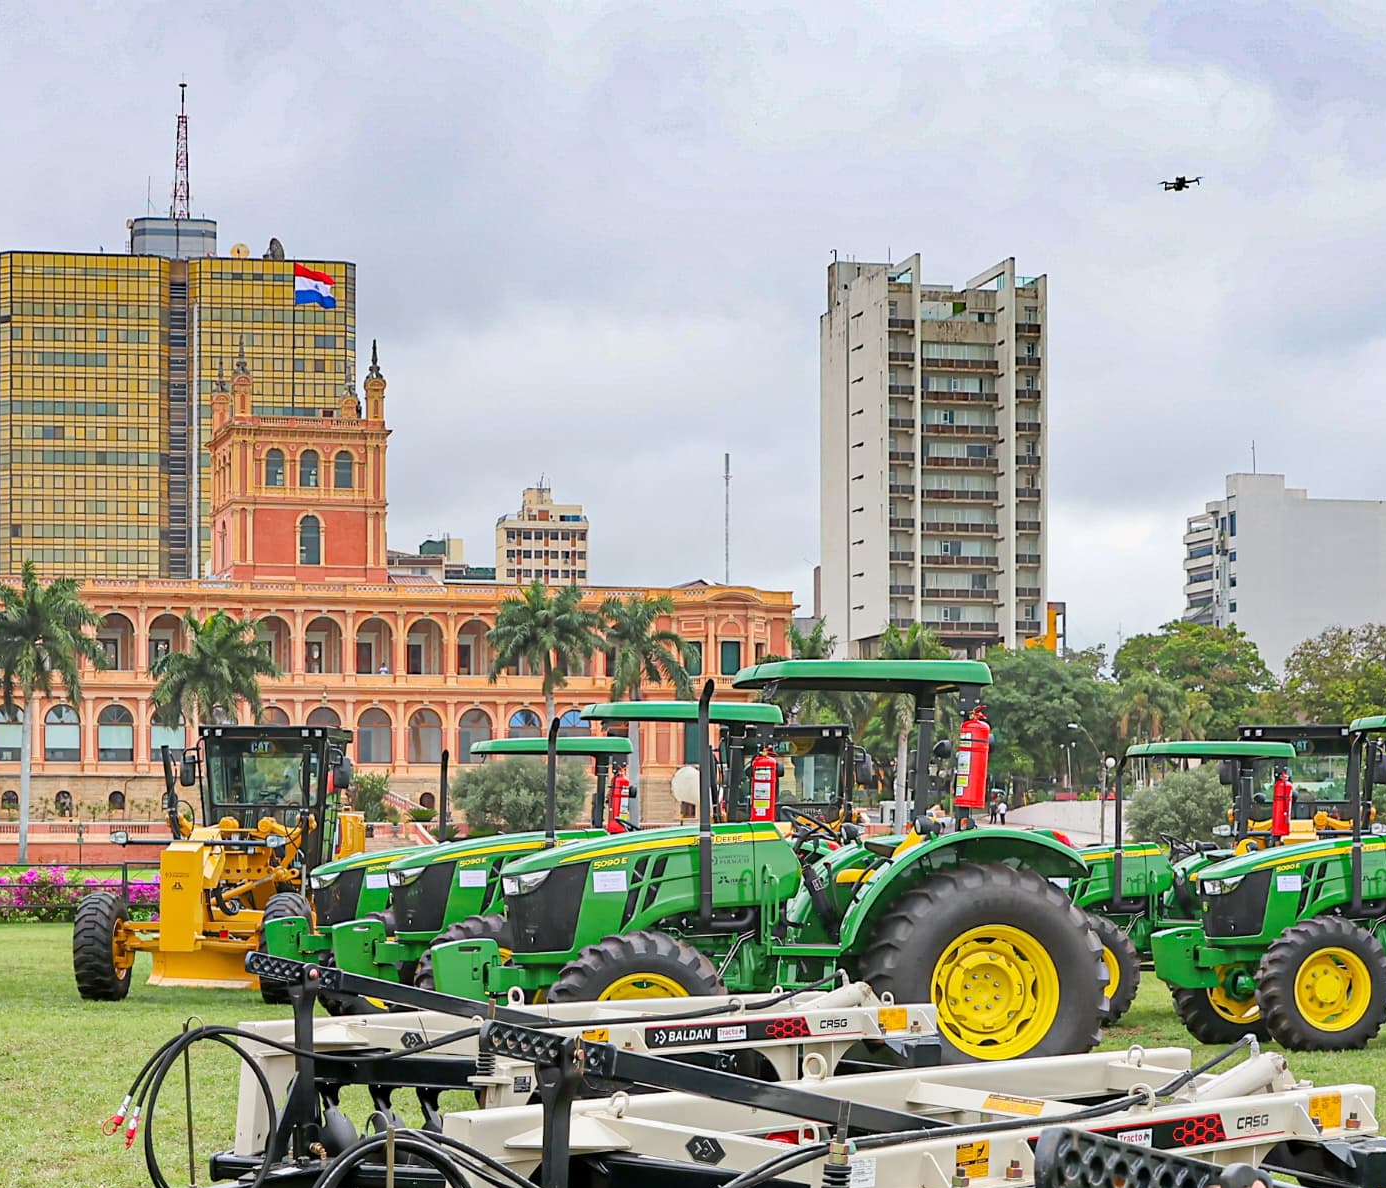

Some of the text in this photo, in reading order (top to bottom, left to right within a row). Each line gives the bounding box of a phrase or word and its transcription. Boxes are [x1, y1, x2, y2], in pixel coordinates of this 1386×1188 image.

[251, 741, 270, 752] CAT
[716, 835, 743, 843] DEERE
[593, 857, 629, 869] 5090 E
[819, 1018, 848, 1029] CRSG
[668, 1028, 711, 1042] BALDAN
[1237, 1114, 1269, 1130] CRSG
[1119, 1131, 1143, 1142] Tracto
